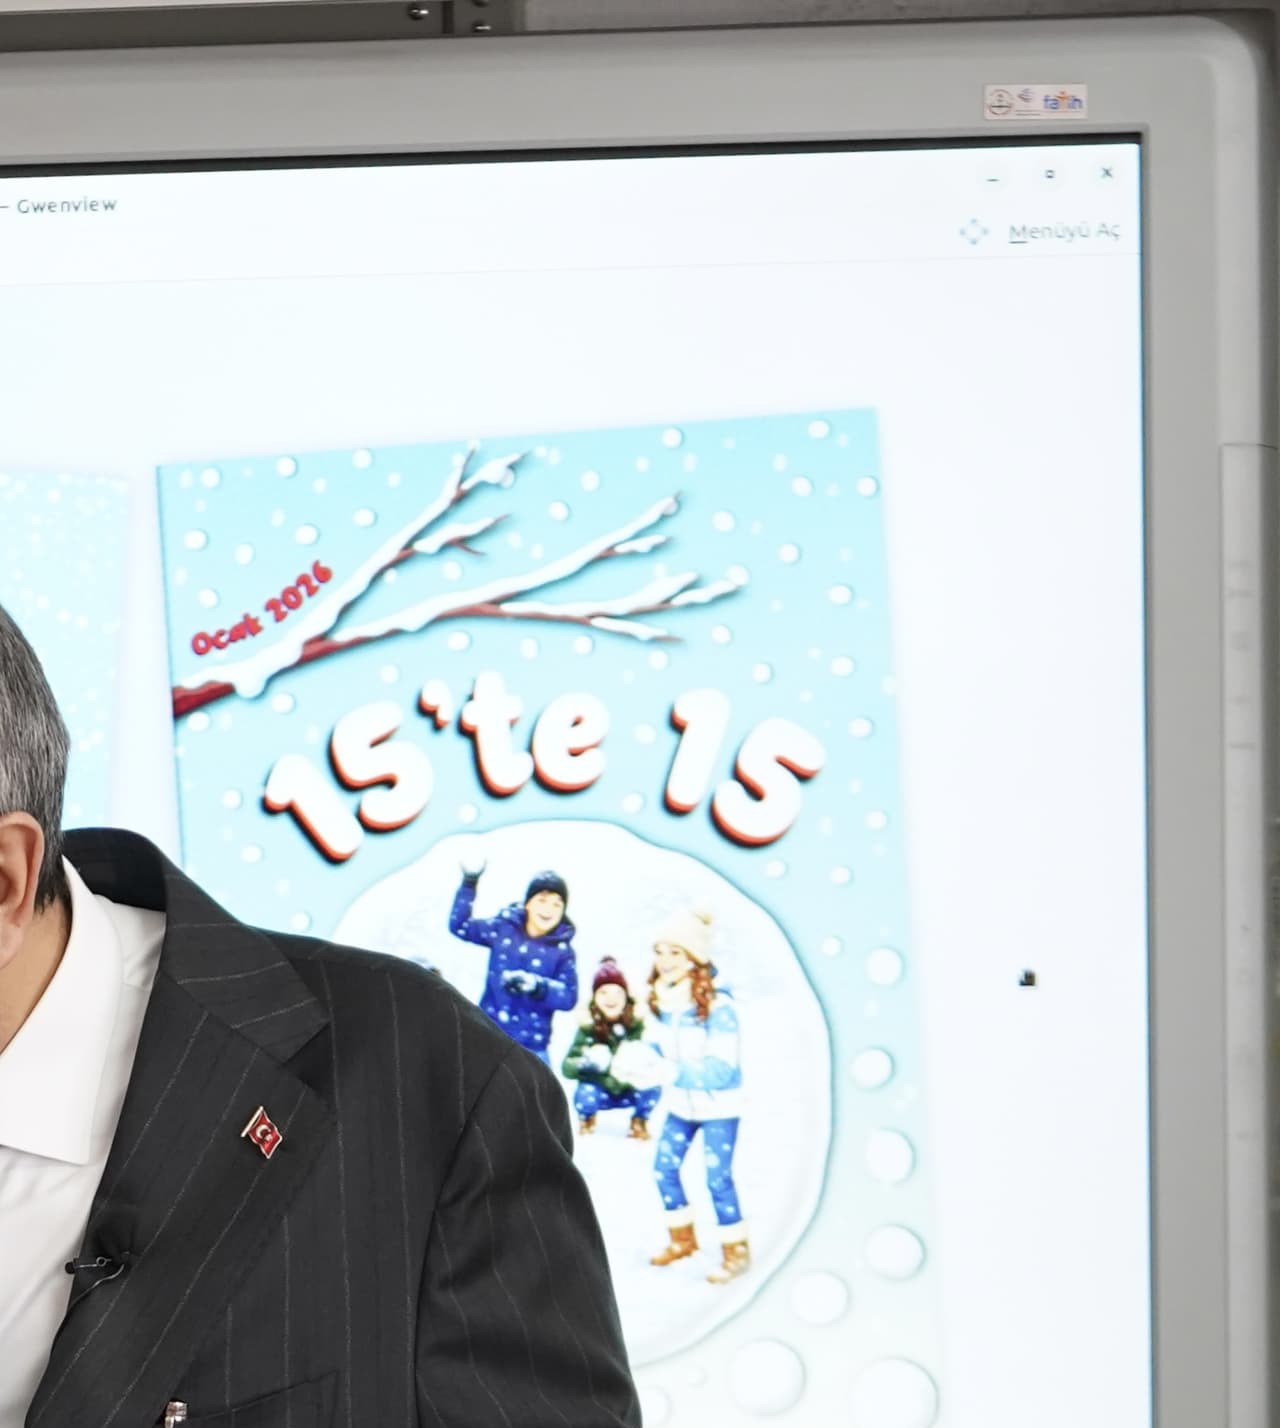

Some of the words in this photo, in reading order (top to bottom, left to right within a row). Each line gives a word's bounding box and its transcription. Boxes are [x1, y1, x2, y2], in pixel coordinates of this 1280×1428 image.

[17, 196, 118, 214] Gwenview
[1009, 221, 1089, 244] Menüyü
[1097, 221, 1121, 240] Aç
[192, 613, 264, 656] Ocak
[264, 559, 333, 623] 2026
[662, 687, 827, 849] 15
